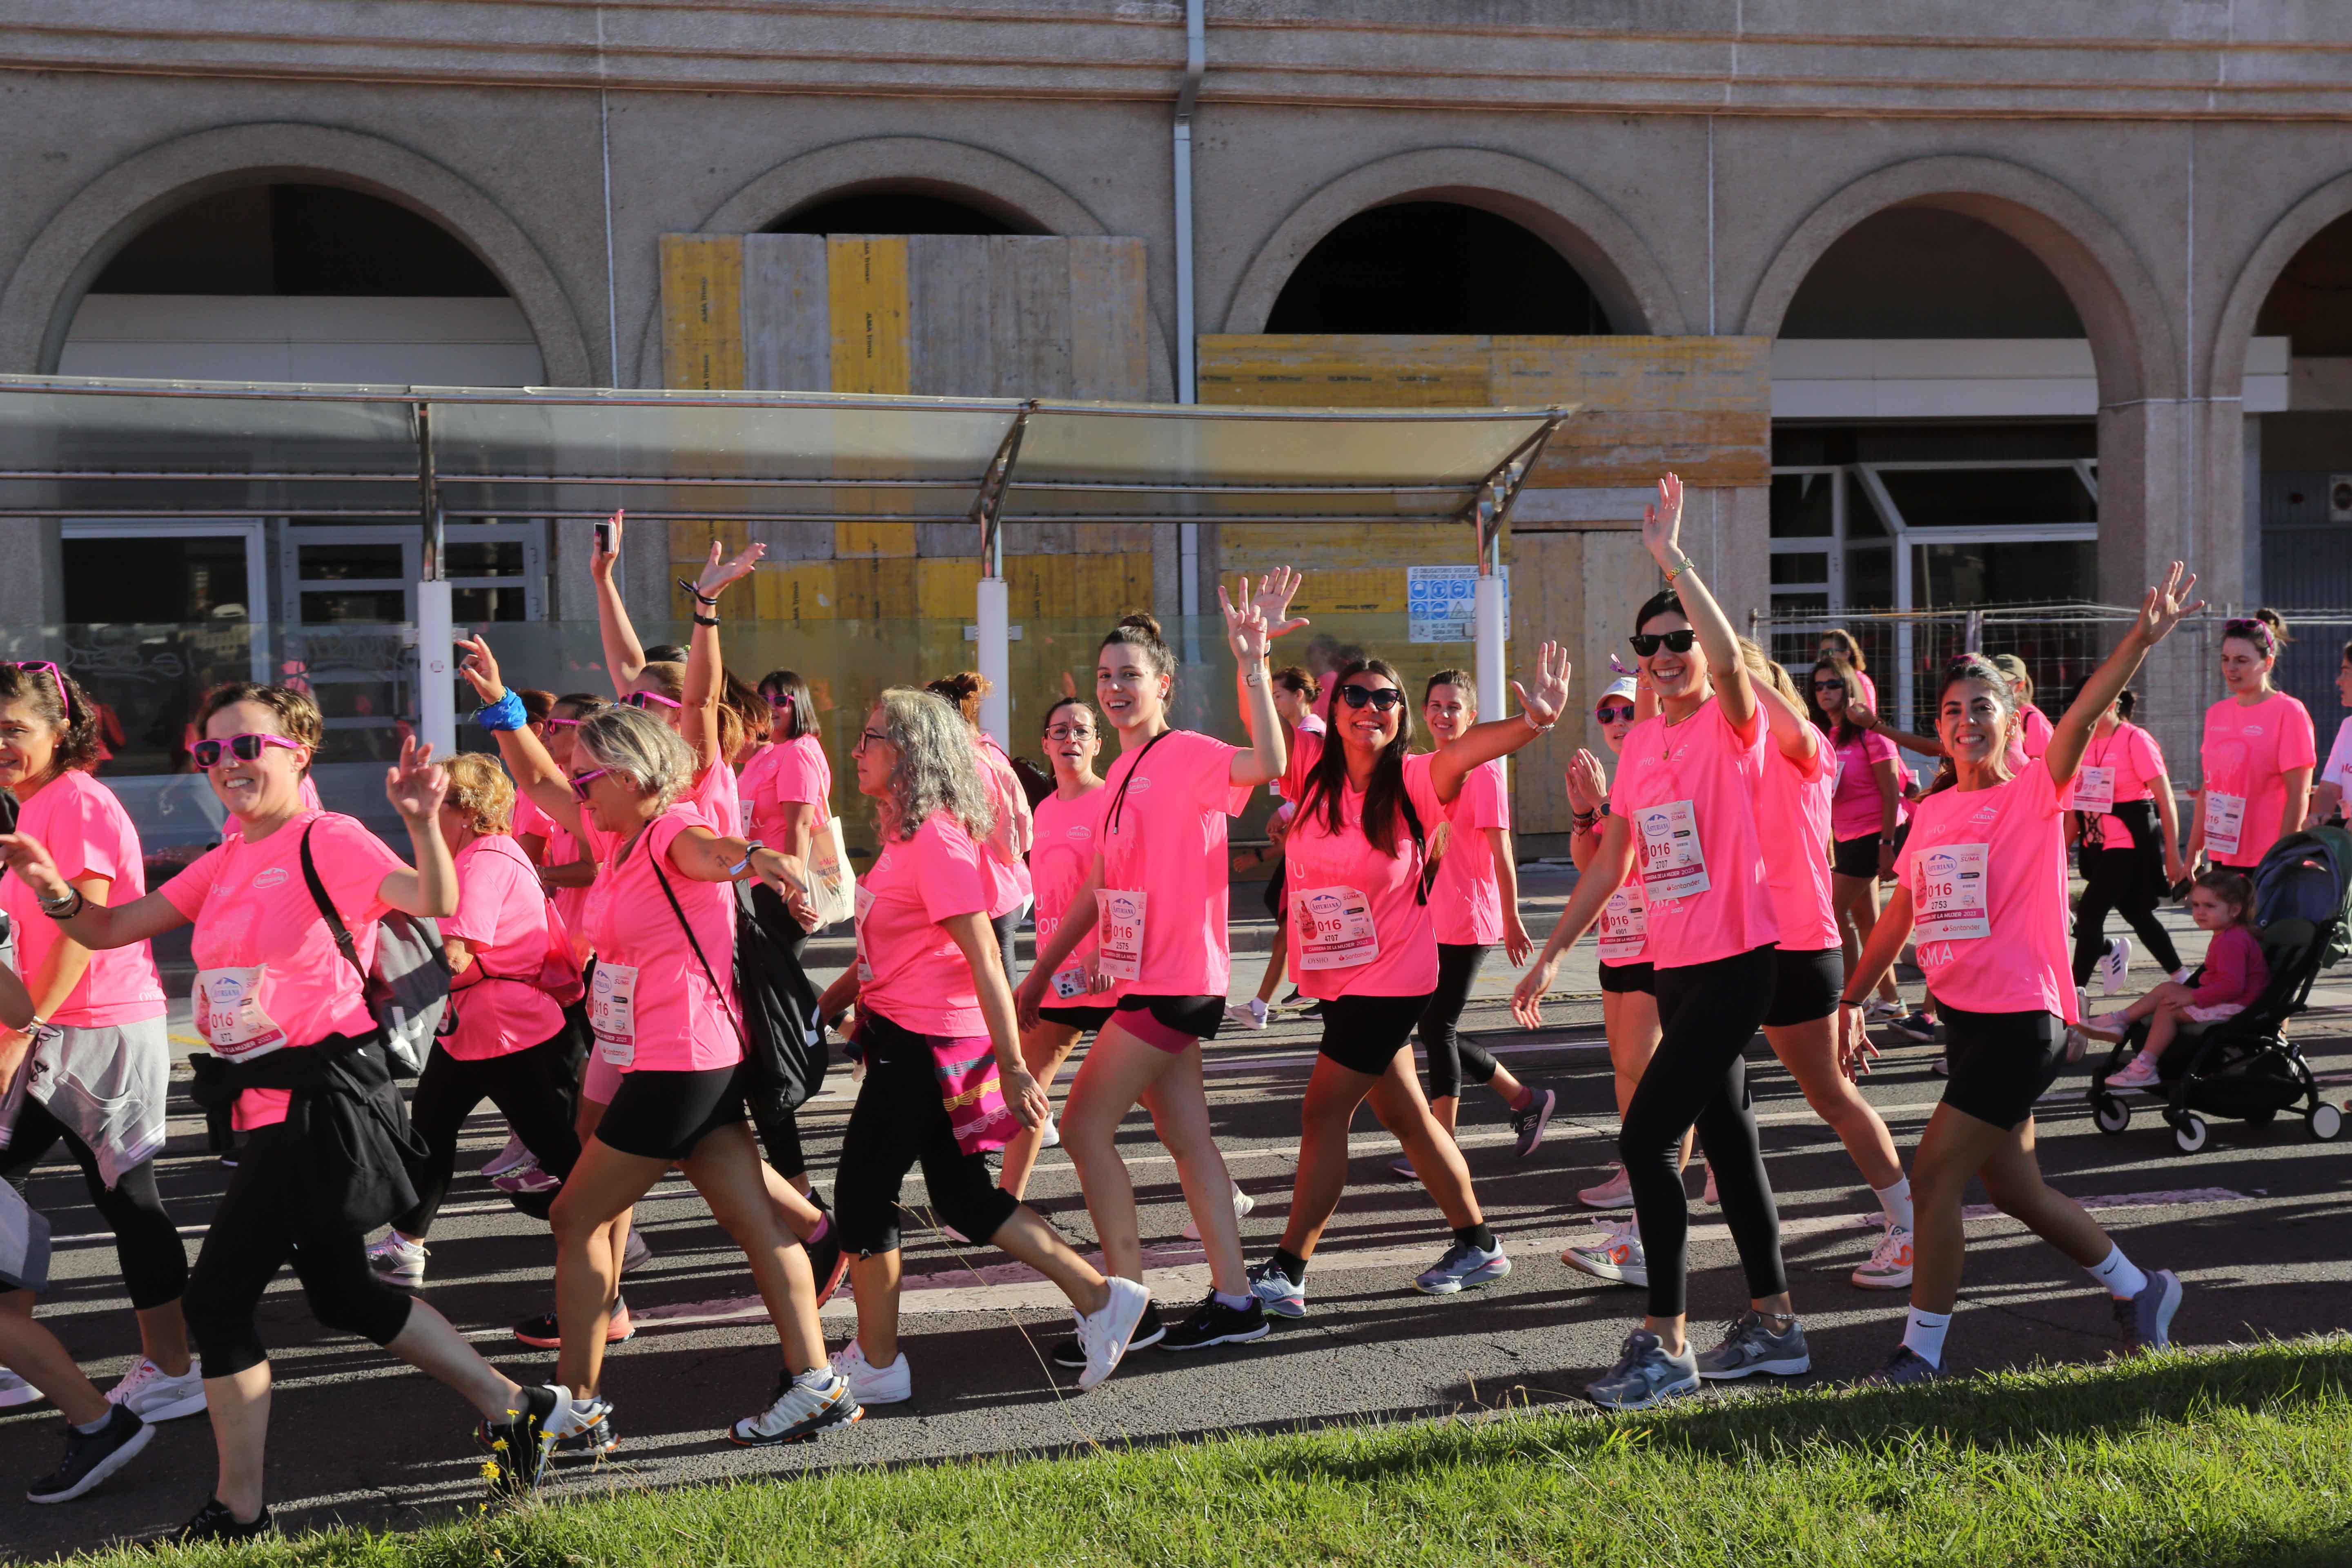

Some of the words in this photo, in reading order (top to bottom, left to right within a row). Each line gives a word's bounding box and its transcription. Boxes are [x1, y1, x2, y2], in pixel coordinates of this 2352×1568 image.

[1650, 842, 1670, 858] 016
[1655, 860, 1668, 869] 2707
[1672, 879, 1700, 891] Santander
[1928, 882, 1952, 898] 016
[1312, 902, 1339, 911] ASTURIANA
[1931, 900, 1947, 910] 2753
[1317, 919, 1342, 932] 016
[1610, 915, 1629, 926] 016
[1113, 925, 1132, 939] 016
[1116, 942, 1129, 950] 2575
[595, 999, 608, 1016] 016
[211, 1011, 234, 1029] 016
